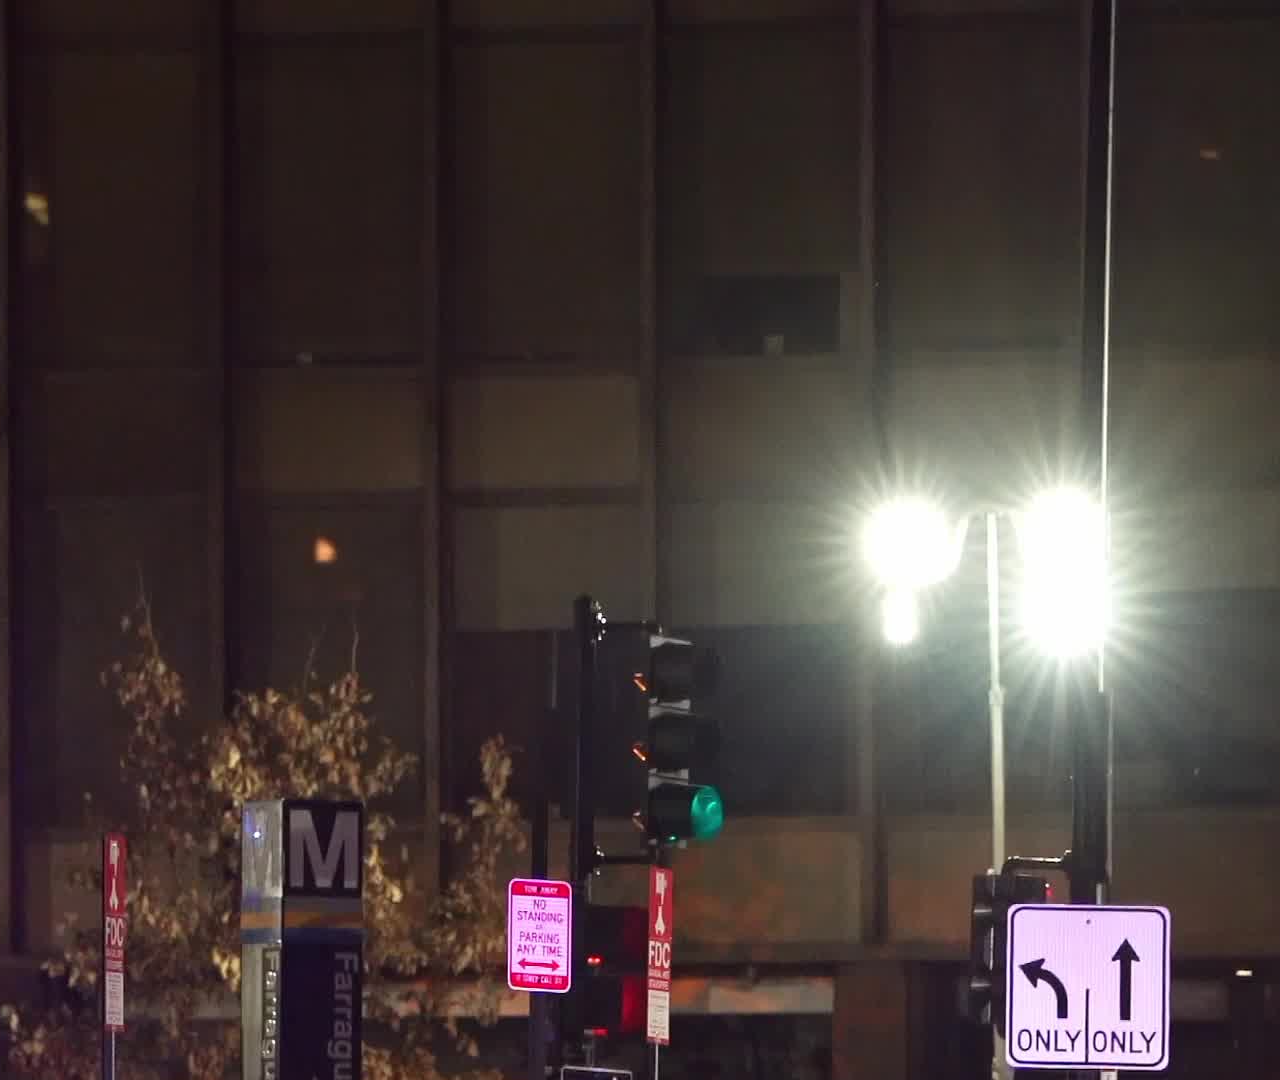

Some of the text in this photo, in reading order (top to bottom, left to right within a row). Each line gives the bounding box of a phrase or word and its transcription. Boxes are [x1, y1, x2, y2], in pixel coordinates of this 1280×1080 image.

[289, 809, 360, 889] M
[533, 900, 547, 910] NO
[517, 911, 563, 923] STANDING
[106, 917, 124, 946] FDC
[519, 931, 559, 944] PARKING
[517, 944, 563, 957] ANY TIME
[649, 940, 671, 968] FDC
[1017, 1029, 1157, 1054] ONLY ONLY
